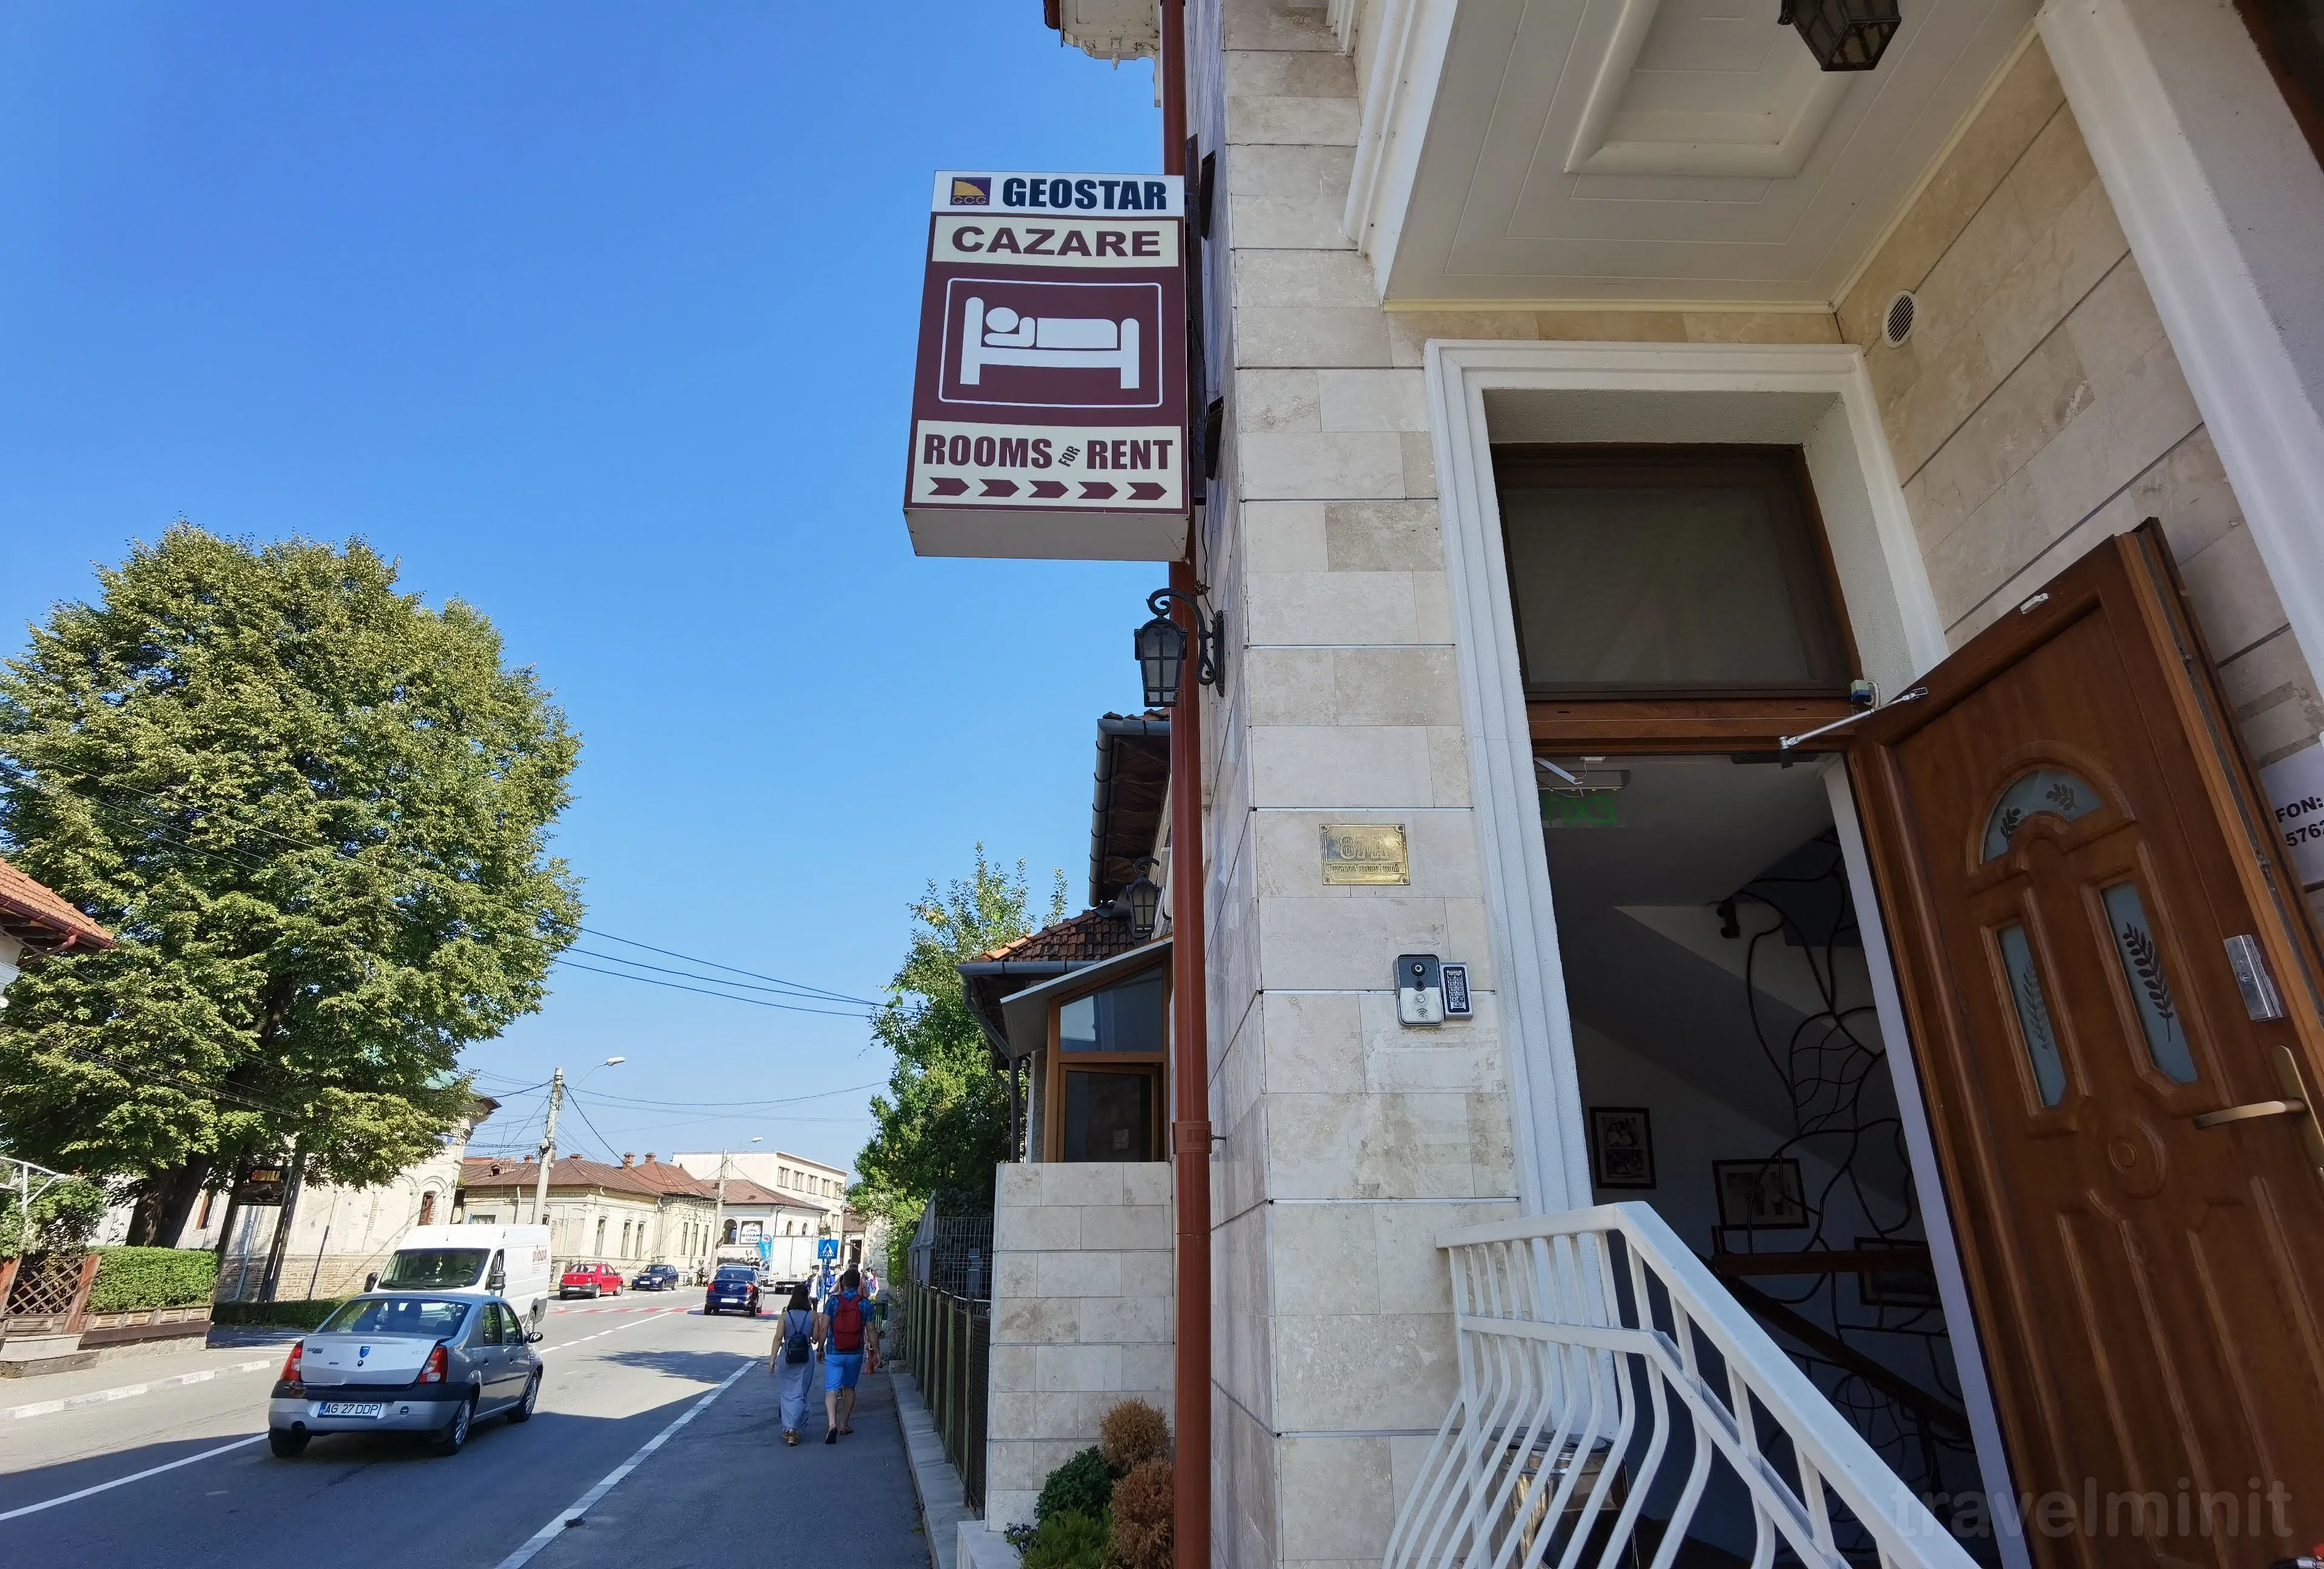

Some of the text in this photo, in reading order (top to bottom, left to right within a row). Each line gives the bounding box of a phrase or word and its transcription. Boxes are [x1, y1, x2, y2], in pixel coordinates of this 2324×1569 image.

[952, 196, 986, 205] GCG
[1002, 177, 1167, 210] GEOSTAR
[951, 226, 1161, 257] CAZARE
[923, 433, 1173, 470] ROOMS FOR RENT
[1340, 835, 1388, 859] 87 A
[324, 1404, 339, 1413] AG
[341, 1404, 355, 1414] 27
